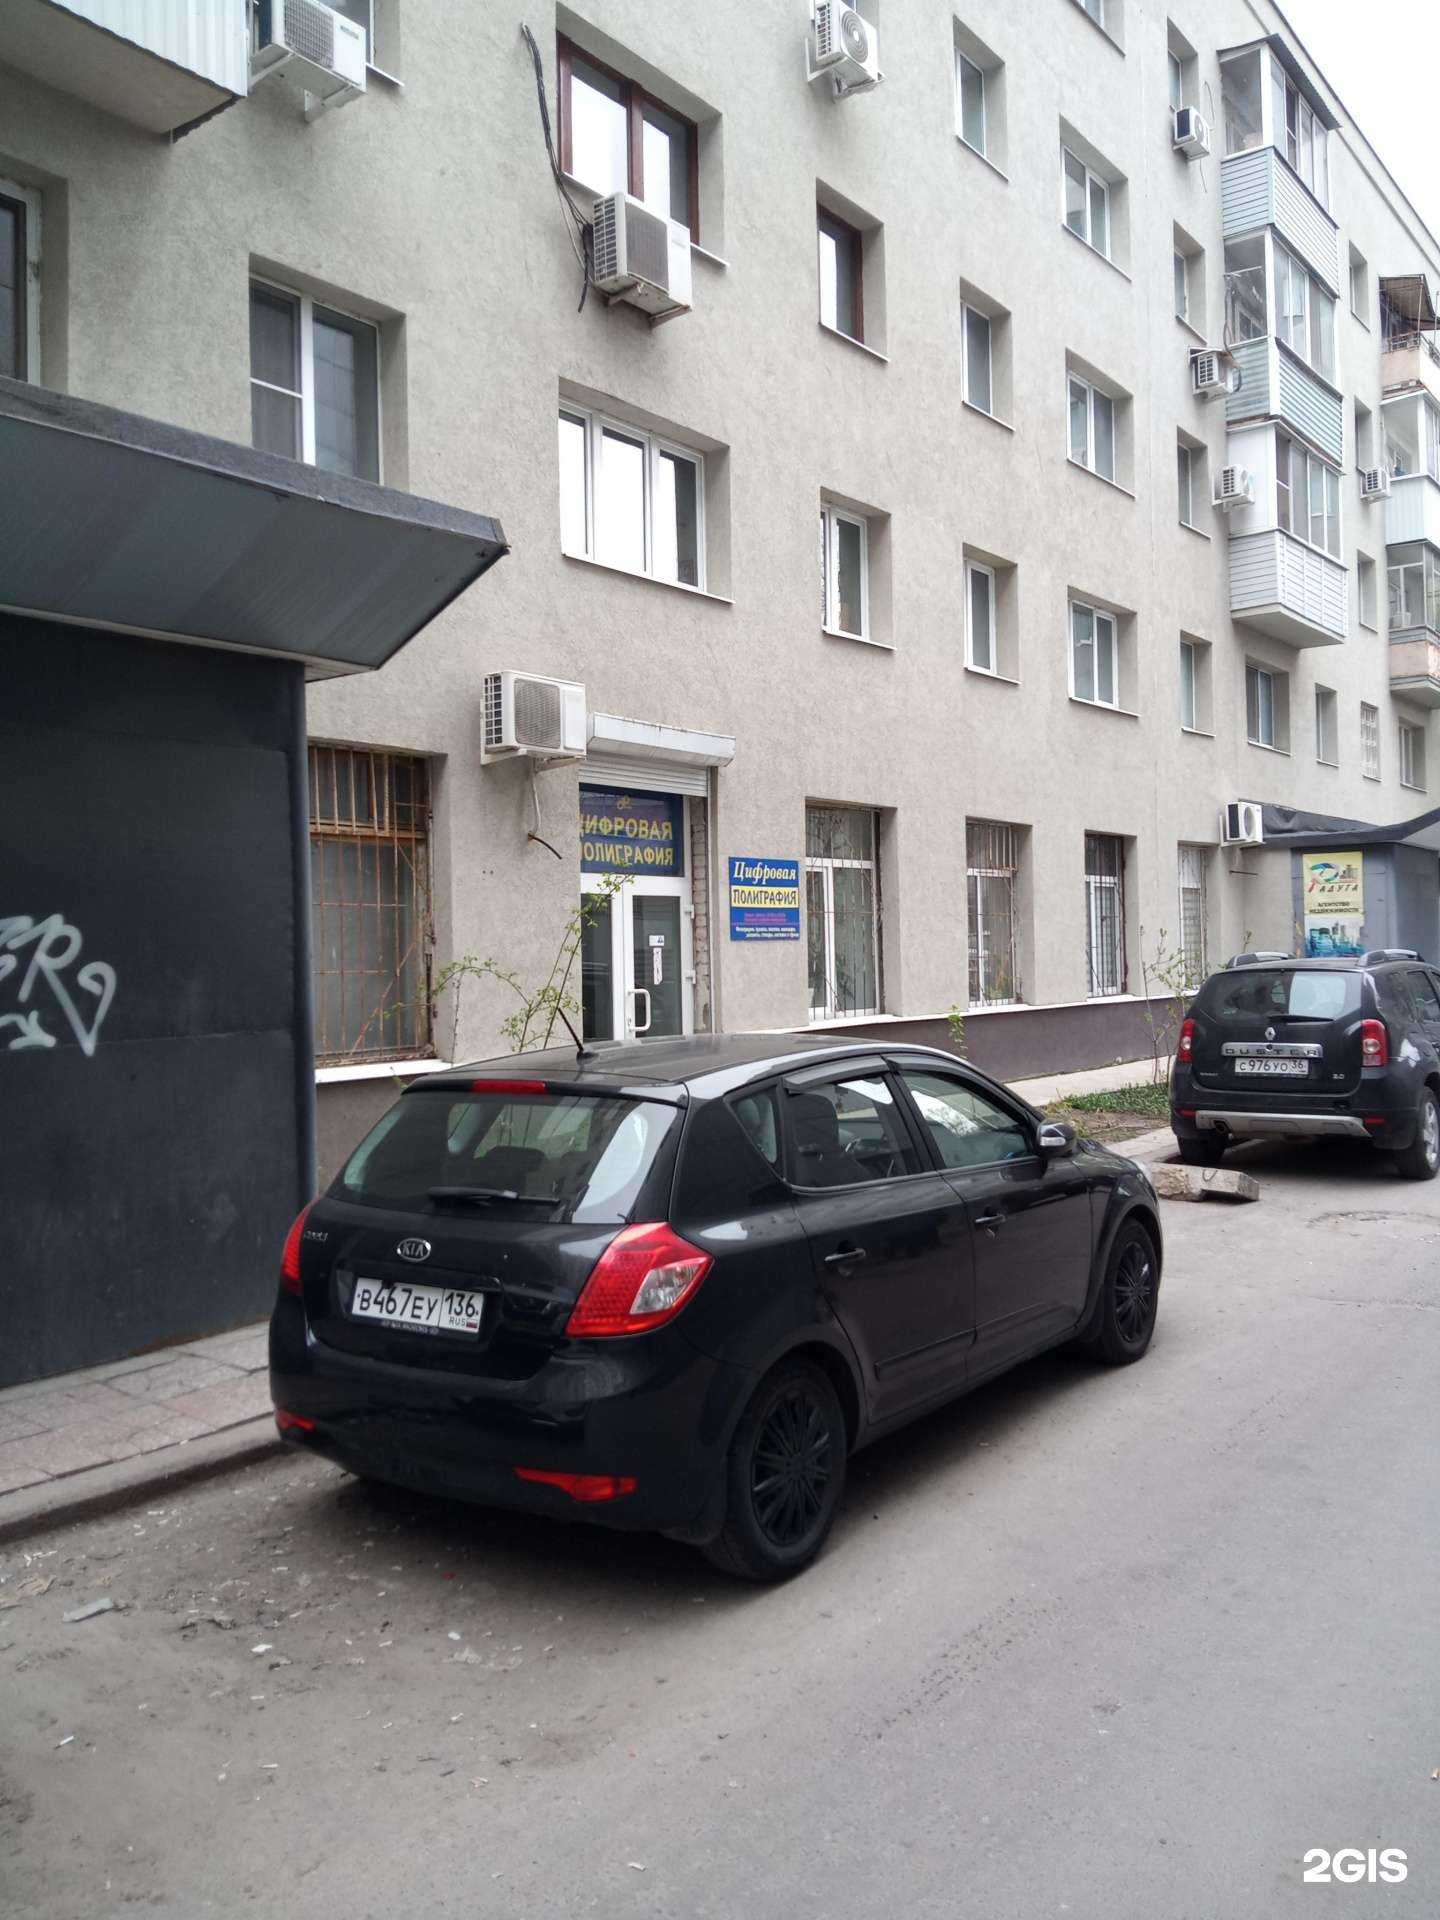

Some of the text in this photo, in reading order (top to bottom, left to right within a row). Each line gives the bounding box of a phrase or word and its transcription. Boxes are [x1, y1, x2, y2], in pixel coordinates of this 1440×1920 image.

[580, 842, 674, 866] ОЛИГРАФИЯ
[733, 861, 797, 885] Цифровая
[733, 889, 797, 905] ПОЛИГРАФИЯ
[1240, 1059, 1288, 1072] С976УО
[403, 1242, 424, 1257] KIA
[360, 1286, 476, 1320] В467ЕУ 136
[449, 1316, 466, 1327] RUS
